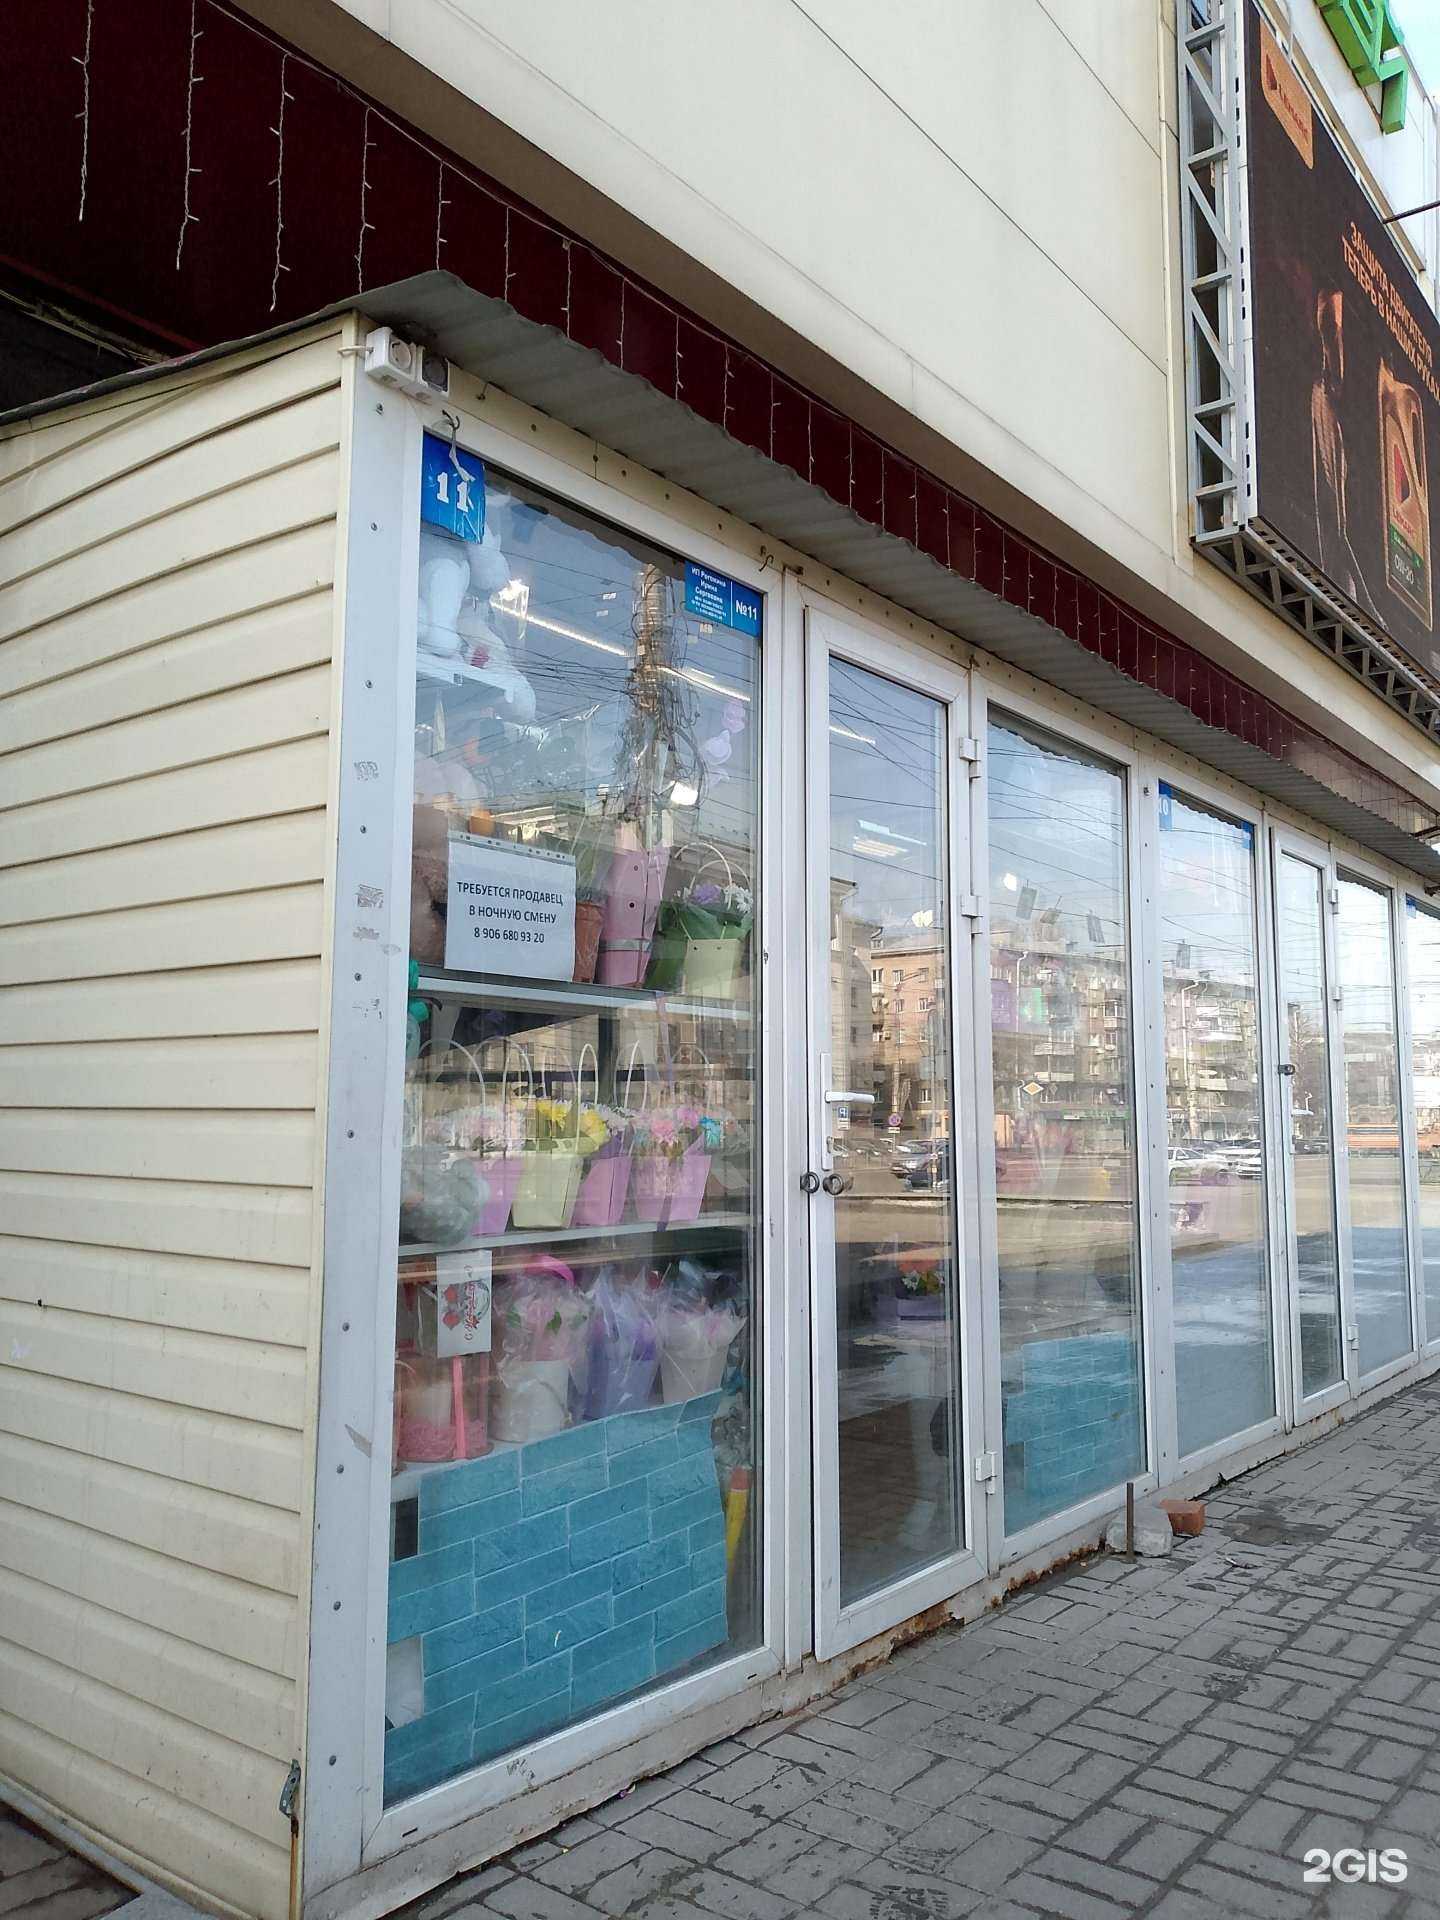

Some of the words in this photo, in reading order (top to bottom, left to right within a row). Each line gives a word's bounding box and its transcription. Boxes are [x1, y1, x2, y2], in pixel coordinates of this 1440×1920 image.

[1341, 234, 1377, 306] ТЕПЕРЬ
[1378, 291, 1385, 318] В
[1386, 303, 1416, 368] НАШИХ
[1351, 221, 1390, 298] ЗАЩИТА
[1390, 282, 1433, 368] ДВИГАТЕЛЯ
[437, 472, 468, 512] 11
[735, 599, 757, 621] №11
[456, 881, 511, 898] ТРЕБУЕТСЯ
[512, 888, 563, 906] ПРОДАВЕЦ
[469, 905, 476, 916] В
[478, 906, 521, 920] НОЧНУЮ
[523, 911, 557, 924] СМЕНУ
[474, 927, 480, 938] 8
[482, 928, 501, 939] 906
[502, 930, 519, 941] 680
[520, 931, 531, 942] 93
[533, 932, 545, 943] 20
